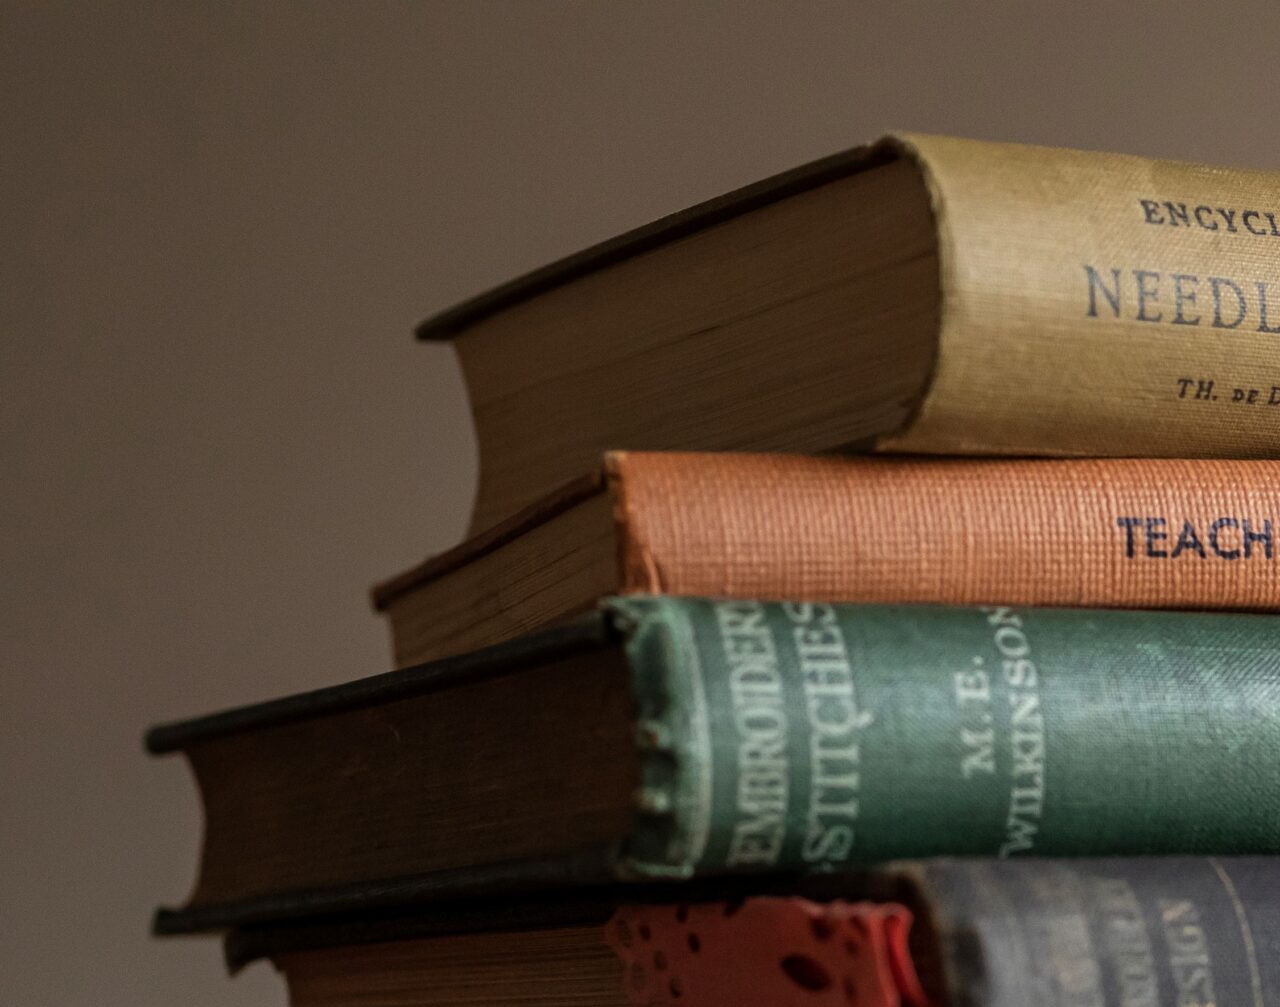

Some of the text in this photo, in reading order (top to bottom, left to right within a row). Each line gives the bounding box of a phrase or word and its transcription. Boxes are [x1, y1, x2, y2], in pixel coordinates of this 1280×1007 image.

[1177, 378, 1217, 402] TH.
[1116, 516, 1273, 562] TEACH
[715, 602, 789, 866] EMBROIDER
[954, 655, 995, 779] M. E.
